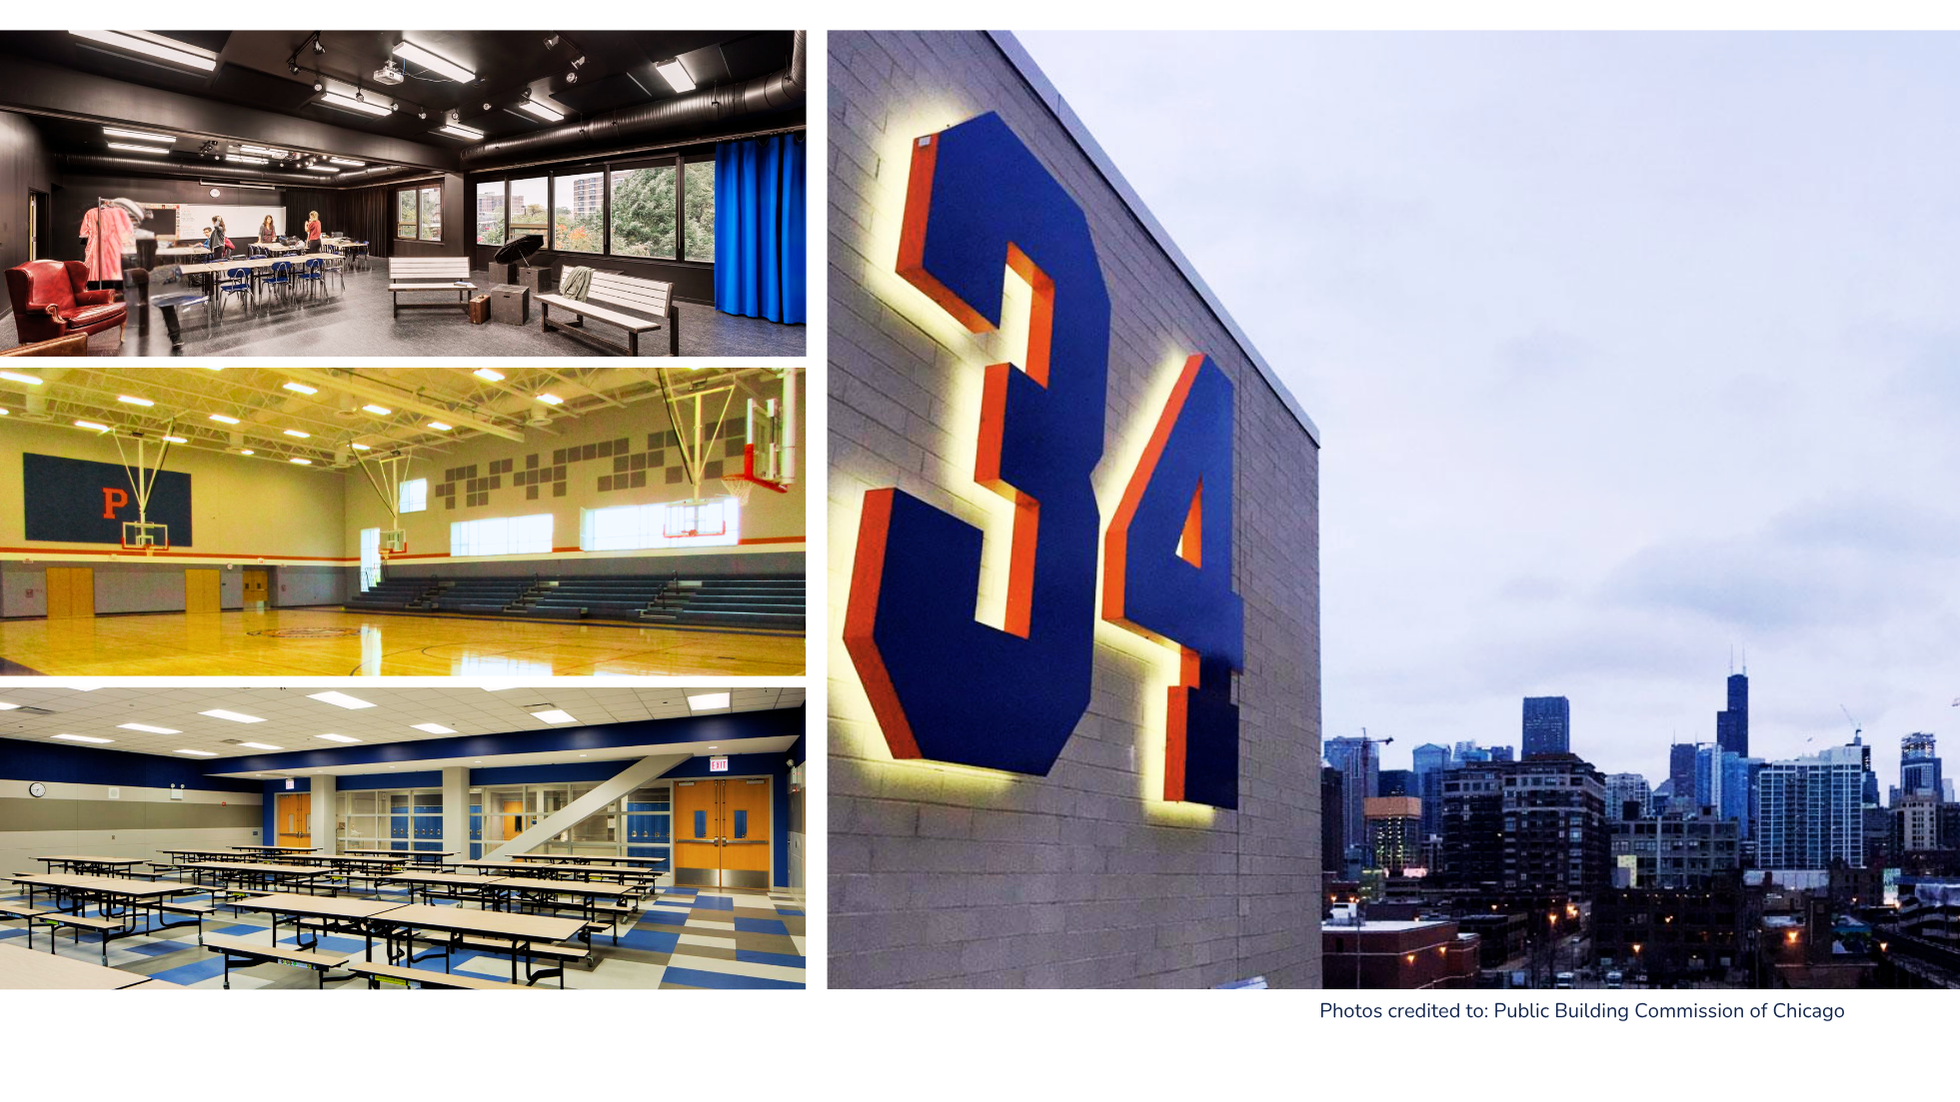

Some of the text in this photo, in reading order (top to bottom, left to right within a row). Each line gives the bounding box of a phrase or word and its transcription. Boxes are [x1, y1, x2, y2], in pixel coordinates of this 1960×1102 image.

[843, 110, 1243, 810] 34
[102, 487, 128, 519] P
[711, 761, 726, 770] EXIT
